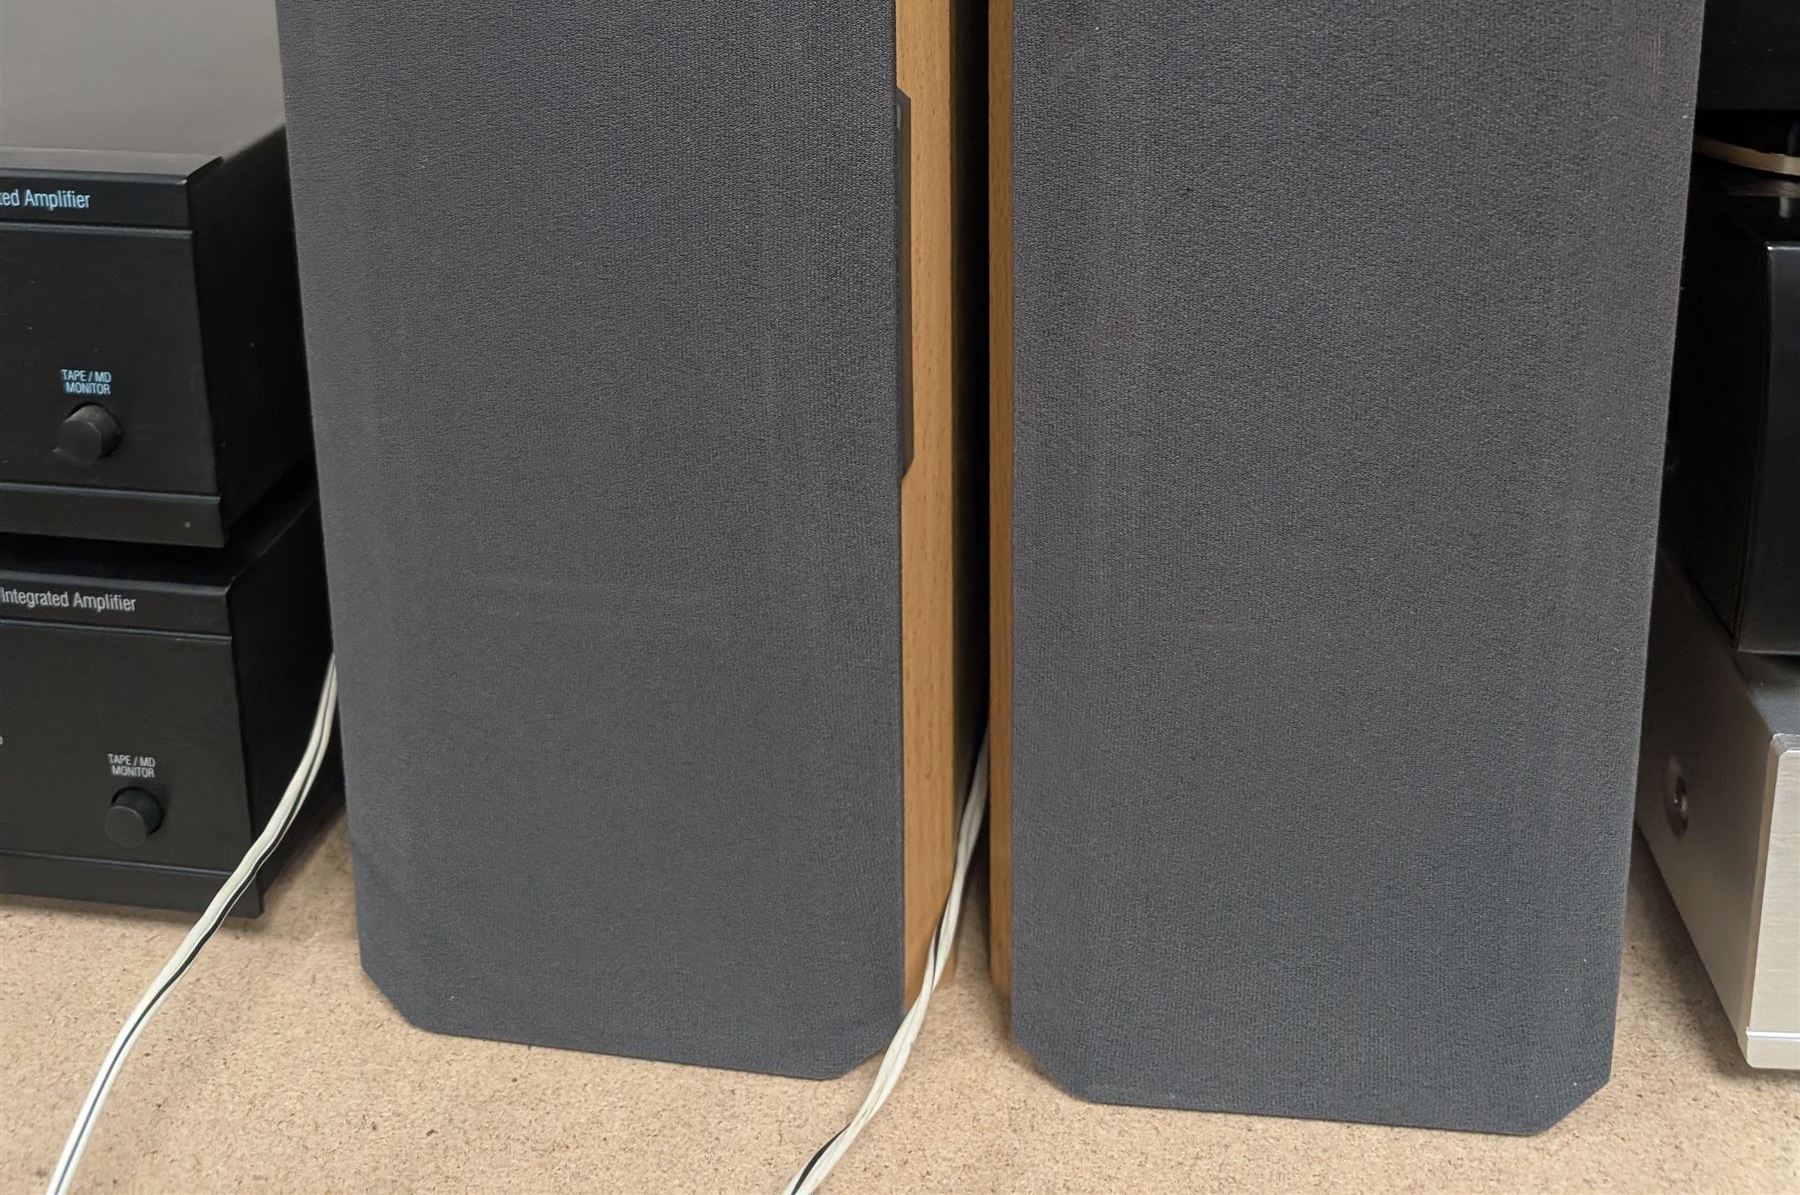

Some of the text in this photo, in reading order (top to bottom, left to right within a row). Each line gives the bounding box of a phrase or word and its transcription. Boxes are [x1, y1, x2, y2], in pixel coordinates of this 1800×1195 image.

[24, 189, 91, 211] Amplifier
[61, 369, 87, 382] TAPE
[94, 371, 112, 383] MD
[65, 381, 111, 395] MONITOR
[0, 587, 136, 612] Integrated Amplifier
[108, 753, 132, 766] TAPE
[139, 756, 156, 768] MD
[111, 765, 156, 778] MONITOR
